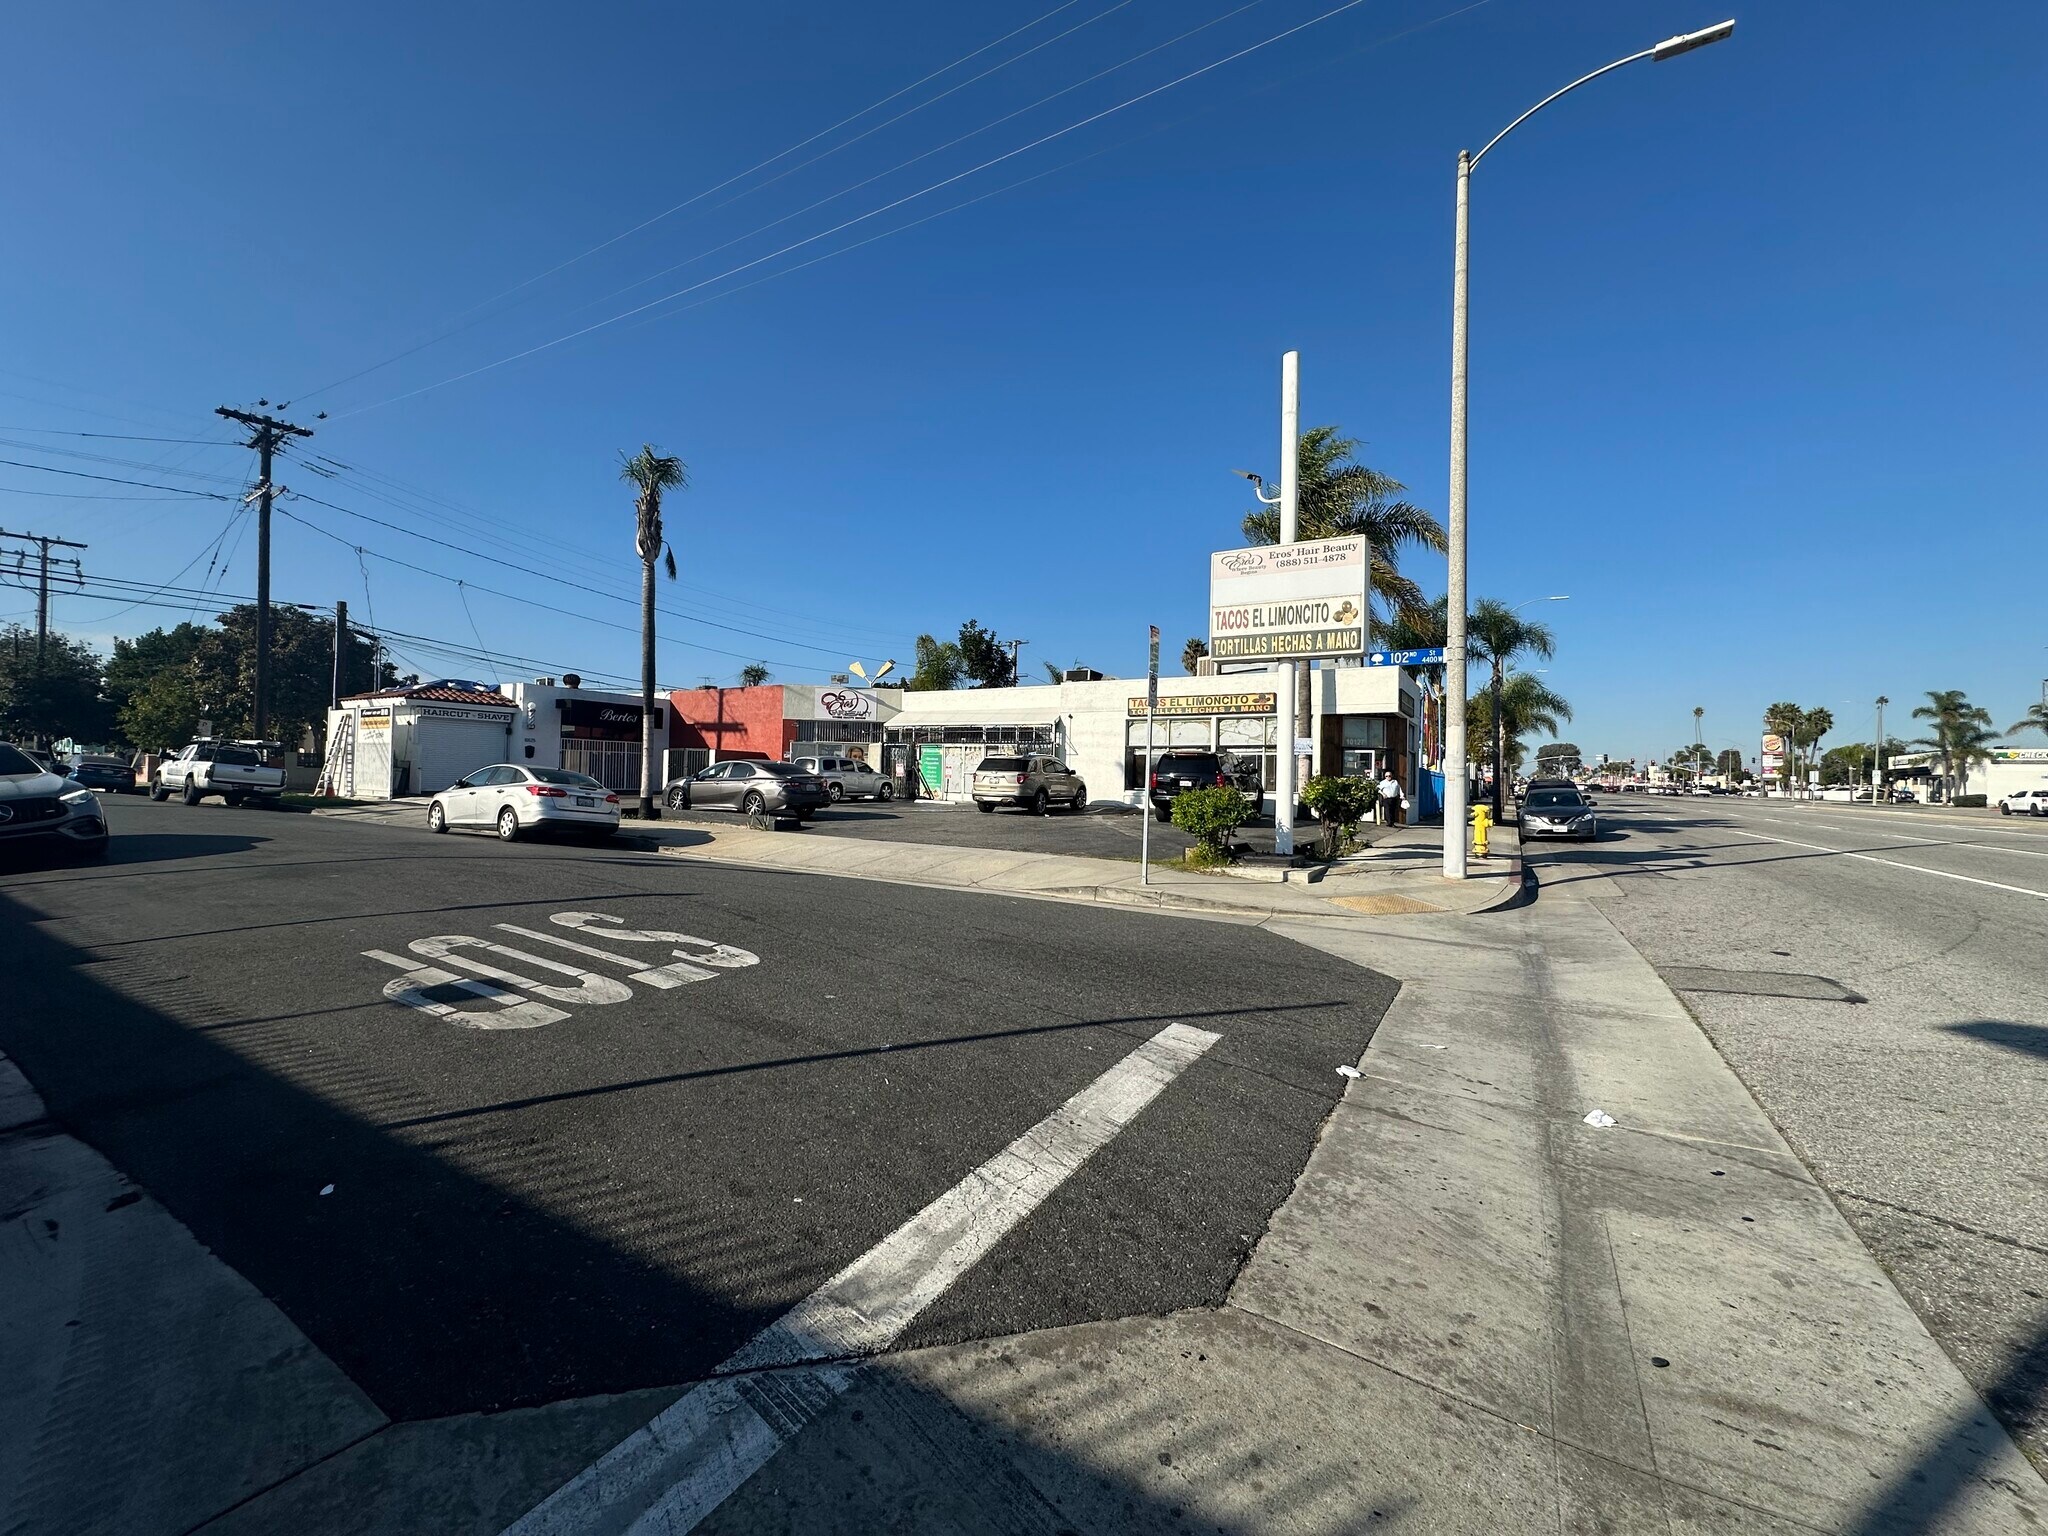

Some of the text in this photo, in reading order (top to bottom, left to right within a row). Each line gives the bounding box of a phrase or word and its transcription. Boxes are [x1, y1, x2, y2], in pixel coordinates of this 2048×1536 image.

[1269, 542, 1358, 560] Eros' Hair Beauty
[1276, 553, 1346, 569] (888) 511-4878
[1215, 602, 1330, 630] TACOS EL LIMONCITO
[1214, 630, 1358, 656] TORTILLAS HECHAS A MANO
[1170, 698, 1183, 706] EL
[1186, 695, 1249, 706] LIMONCITO
[422, 708, 510, 721] HAIRCUT SHAVE
[1185, 706, 1225, 714] HECHAS
[1240, 704, 1271, 712] MANO
[1346, 738, 1365, 746] 10127
[2018, 751, 2048, 759] CHECK
[360, 910, 760, 1029] STOP
